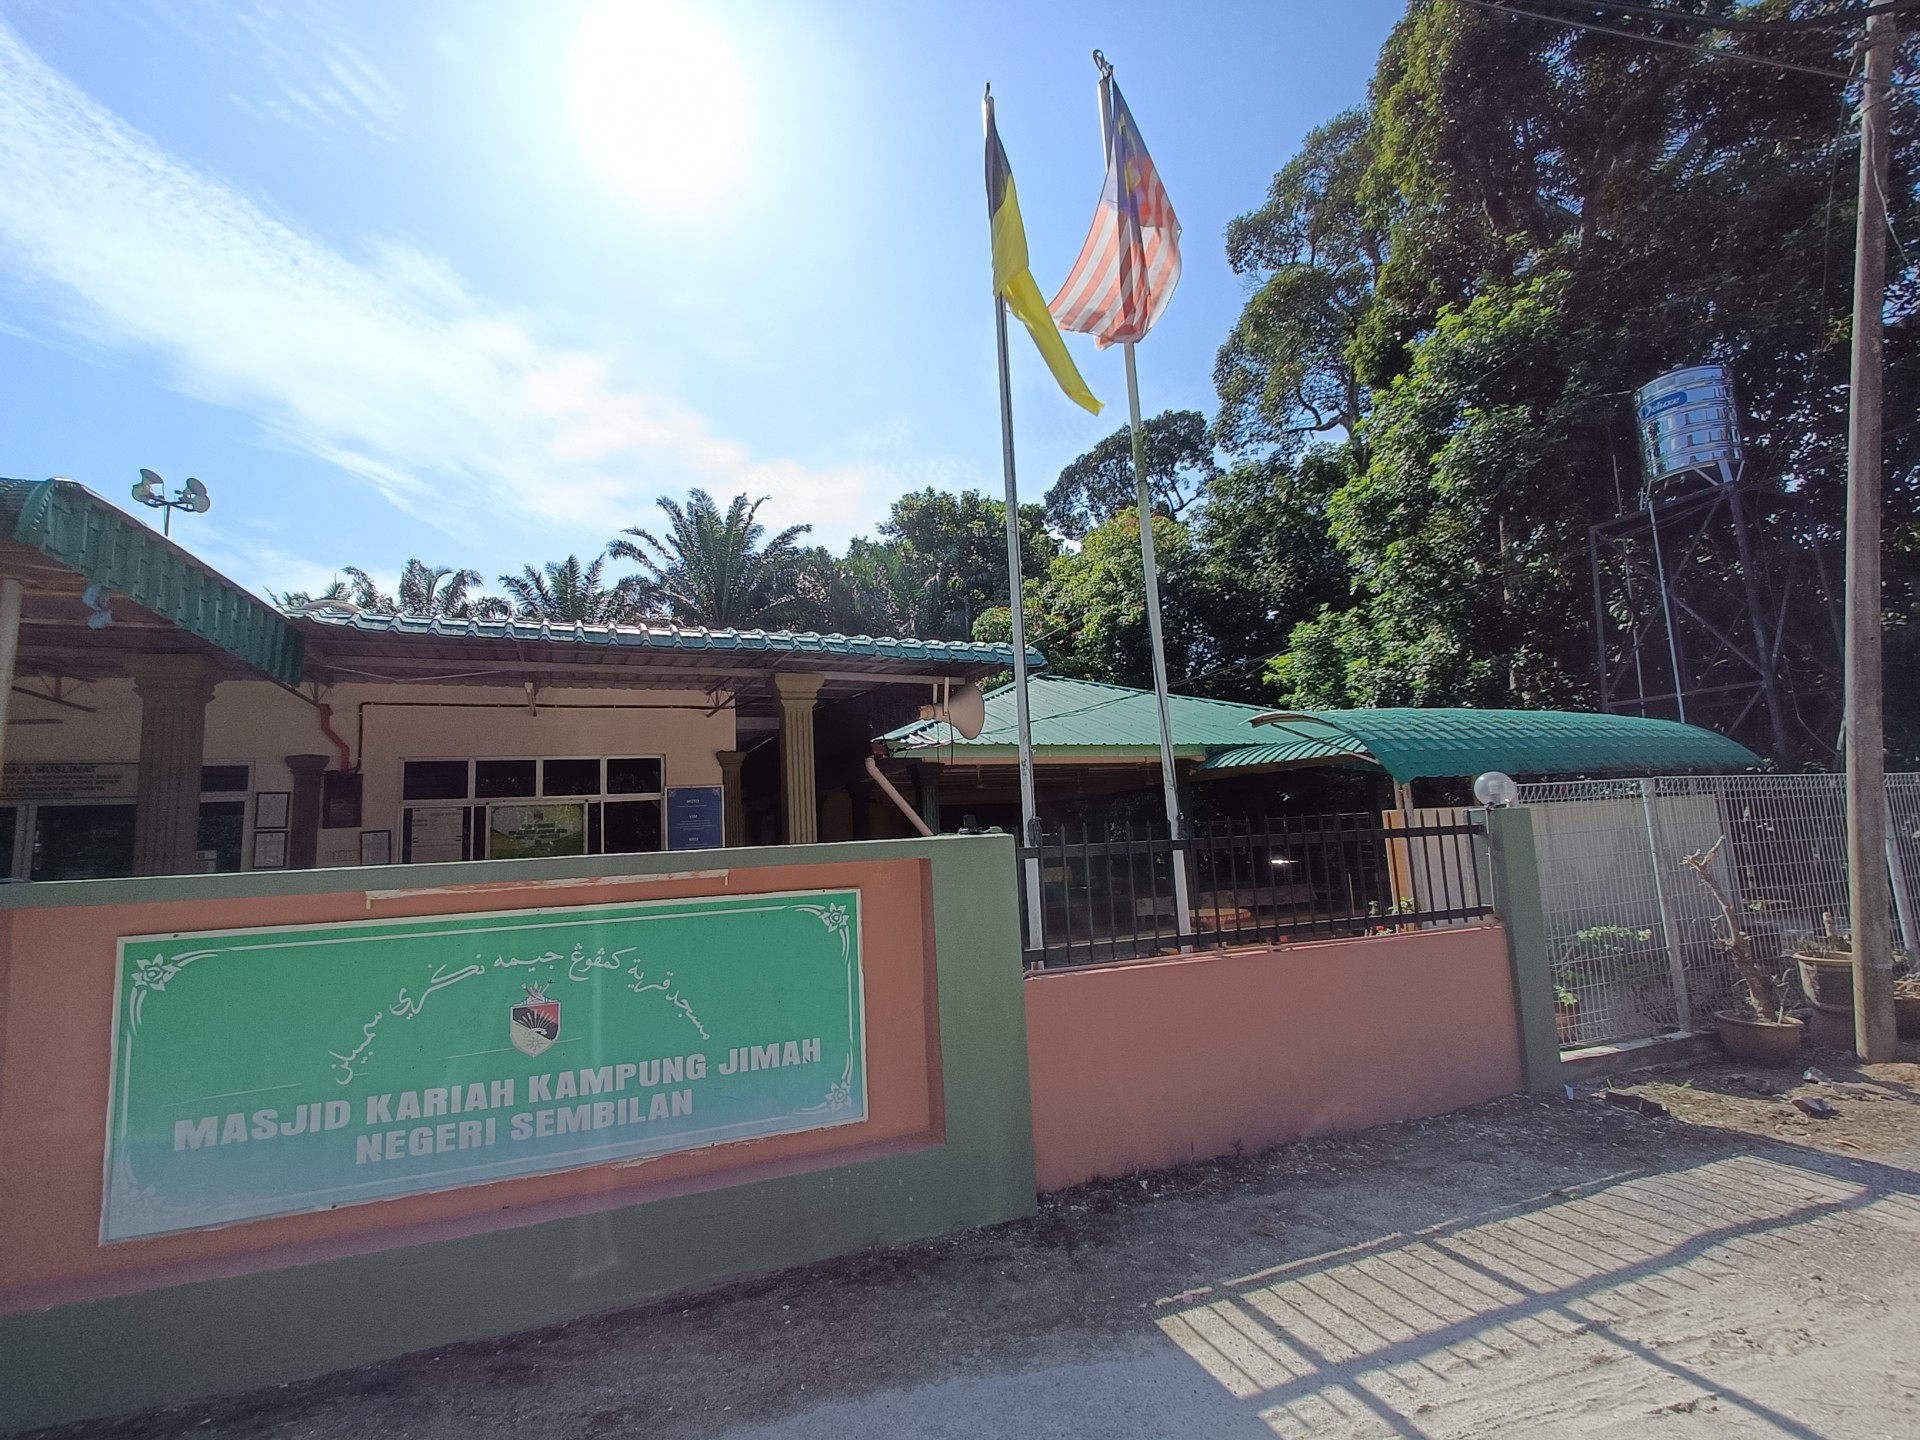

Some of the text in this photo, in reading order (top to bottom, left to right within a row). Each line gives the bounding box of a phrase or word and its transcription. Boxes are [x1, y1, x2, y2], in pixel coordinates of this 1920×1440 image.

[1643, 396, 1681, 417] Deluxe
[493, 950, 564, 972] جيمه
[627, 958, 674, 992] قرية
[665, 990, 710, 1040] مسجد
[173, 1037, 821, 1152] MASJID KARIAH KAMPUNG JIMAH
[355, 1088, 693, 1165] NEGERI SEMBILAN
